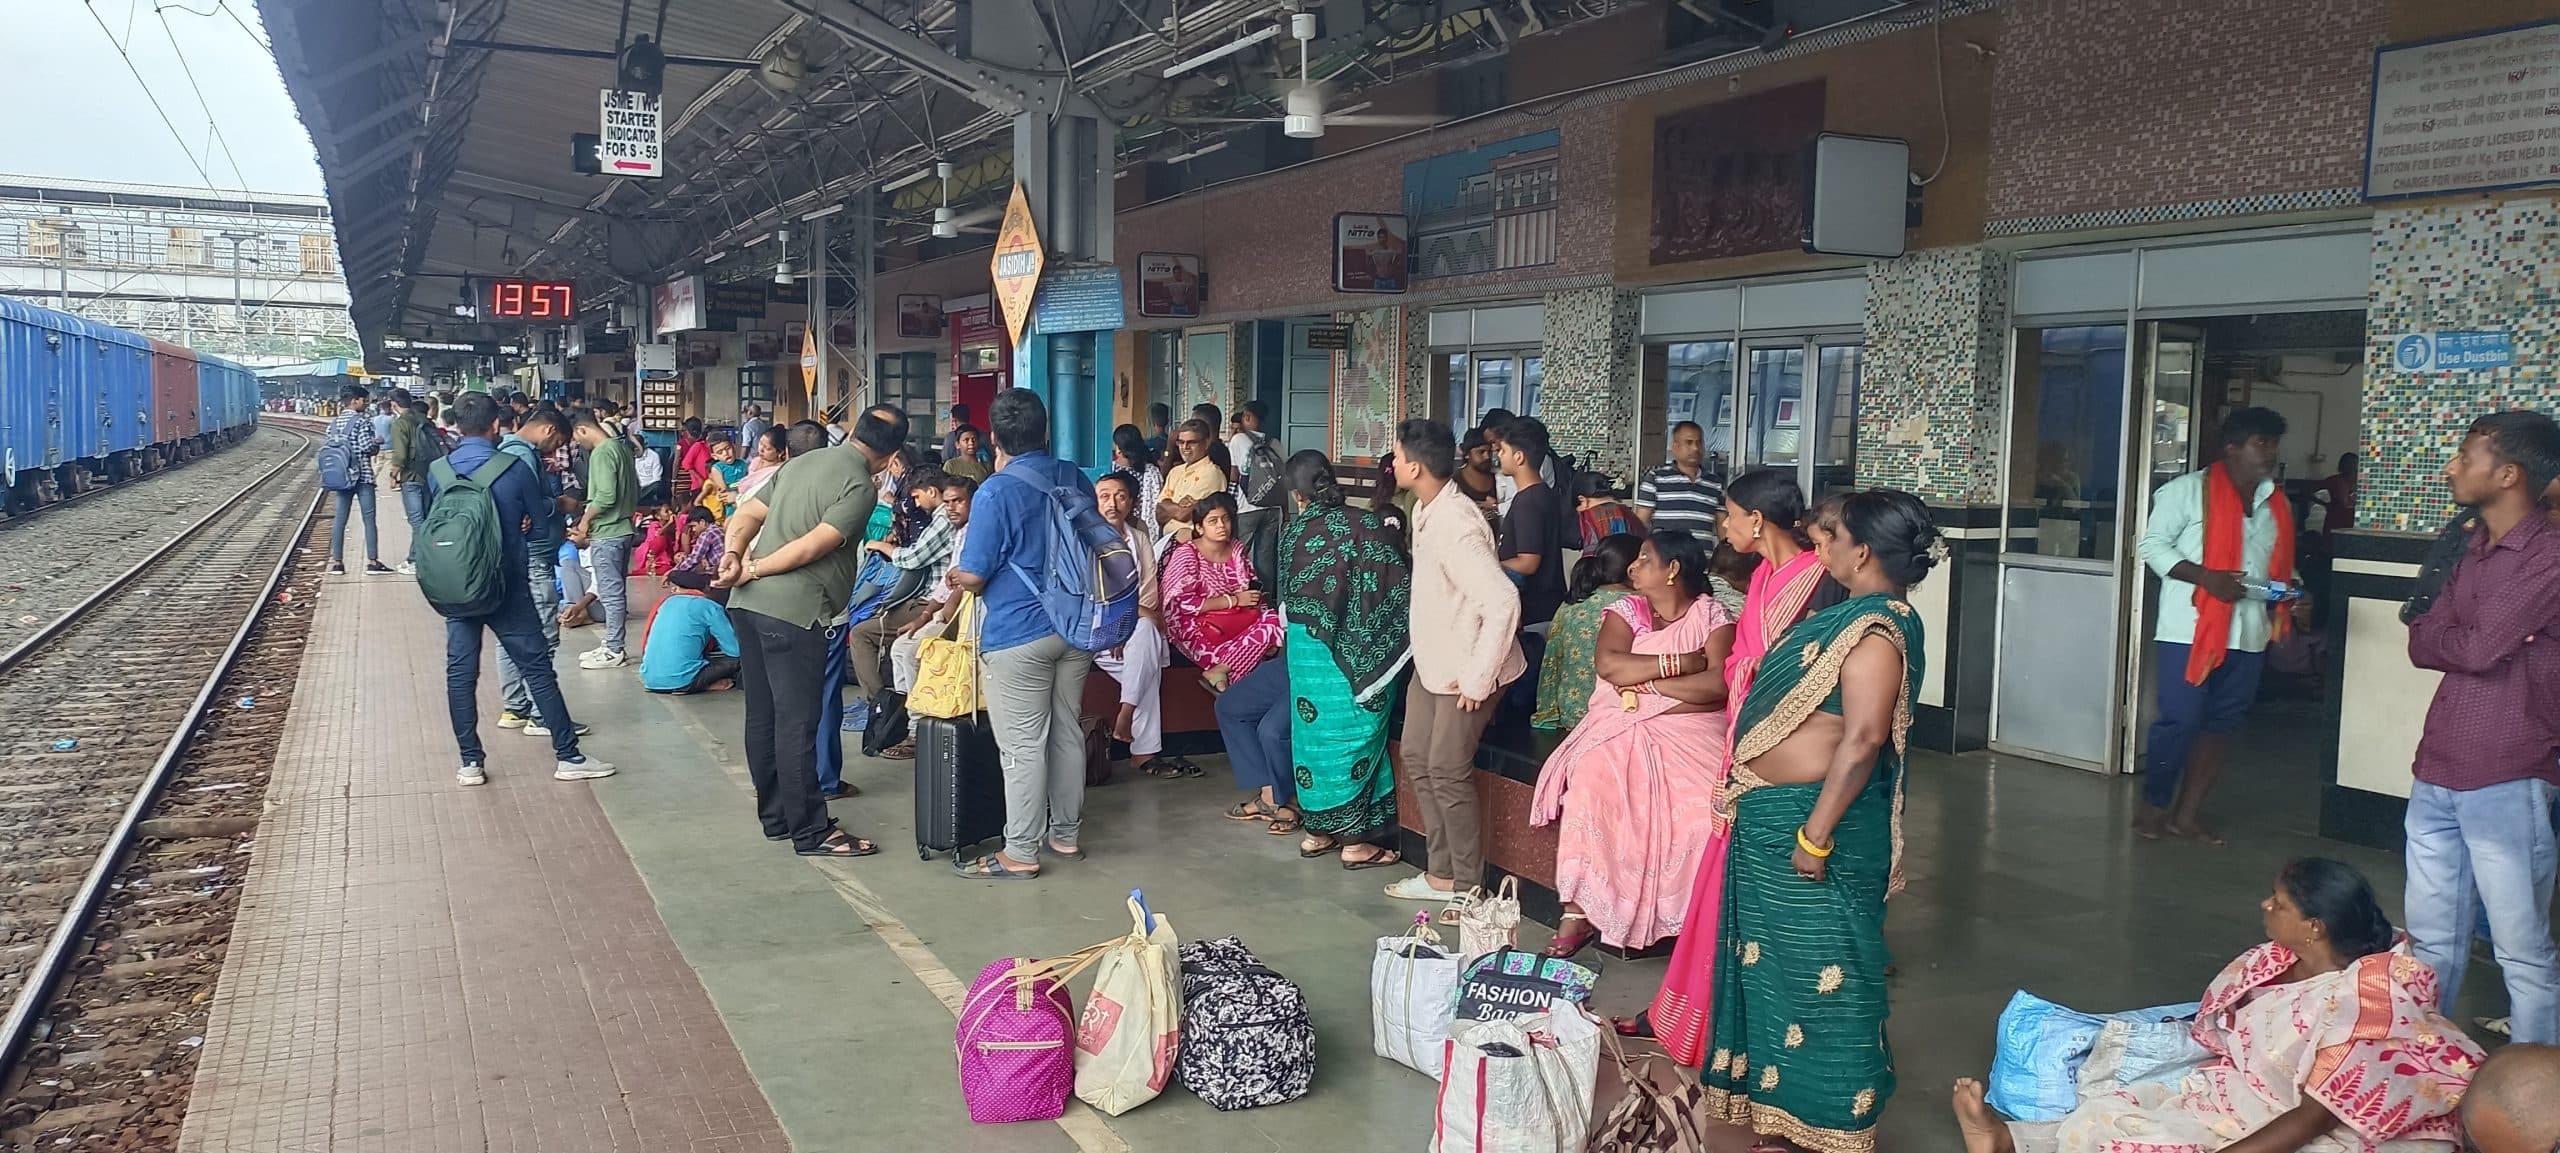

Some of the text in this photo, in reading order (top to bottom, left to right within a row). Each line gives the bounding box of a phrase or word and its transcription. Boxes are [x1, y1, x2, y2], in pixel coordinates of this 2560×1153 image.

[607, 111, 656, 128] STARTER
[607, 126, 656, 143] INDICATOR
[2433, 138, 2470, 152] CHARGE
[2487, 130, 2535, 145] LICENSED
[605, 142, 627, 157] FOR
[630, 144, 636, 157] S
[646, 145, 657, 159] 59
[2496, 149, 2516, 162] PER
[2518, 146, 2545, 160] HEAD
[2487, 168, 2518, 182] CHAIR
[1348, 229, 1375, 237] NITRO
[999, 252, 1025, 276] JASIDIH
[2438, 349, 2509, 364] Use Dustbin
[1466, 982, 1551, 1008] FASHION
